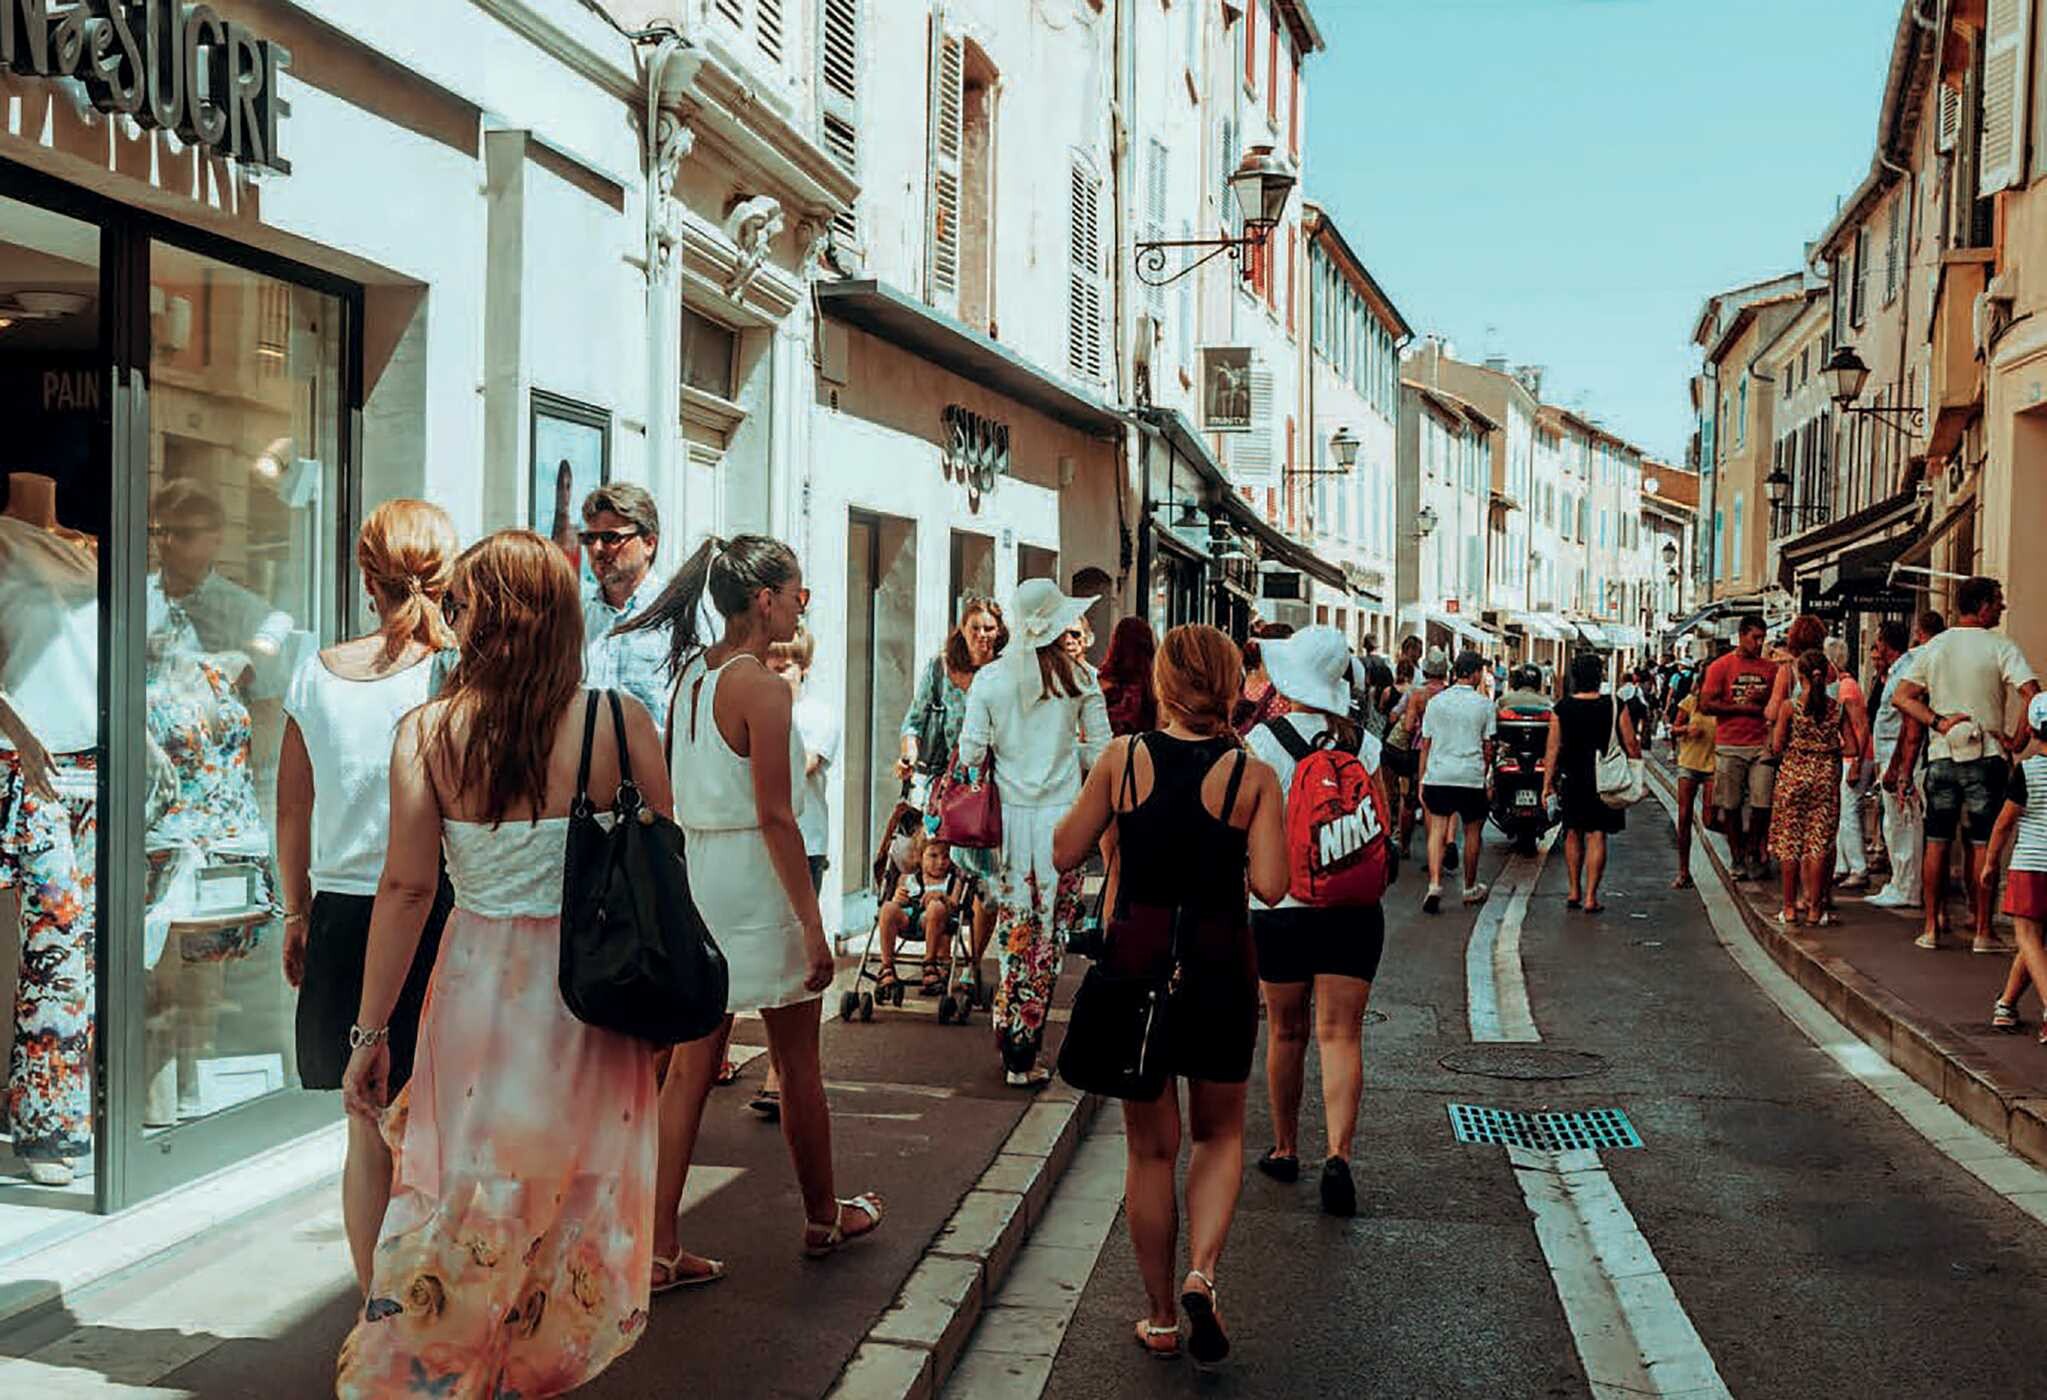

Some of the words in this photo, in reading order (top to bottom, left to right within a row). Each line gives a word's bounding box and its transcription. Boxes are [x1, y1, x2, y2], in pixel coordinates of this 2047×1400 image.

[107, 0, 292, 175] SUCRE
[43, 371, 100, 411] PAIN
[1319, 794, 1382, 867] NIKE
